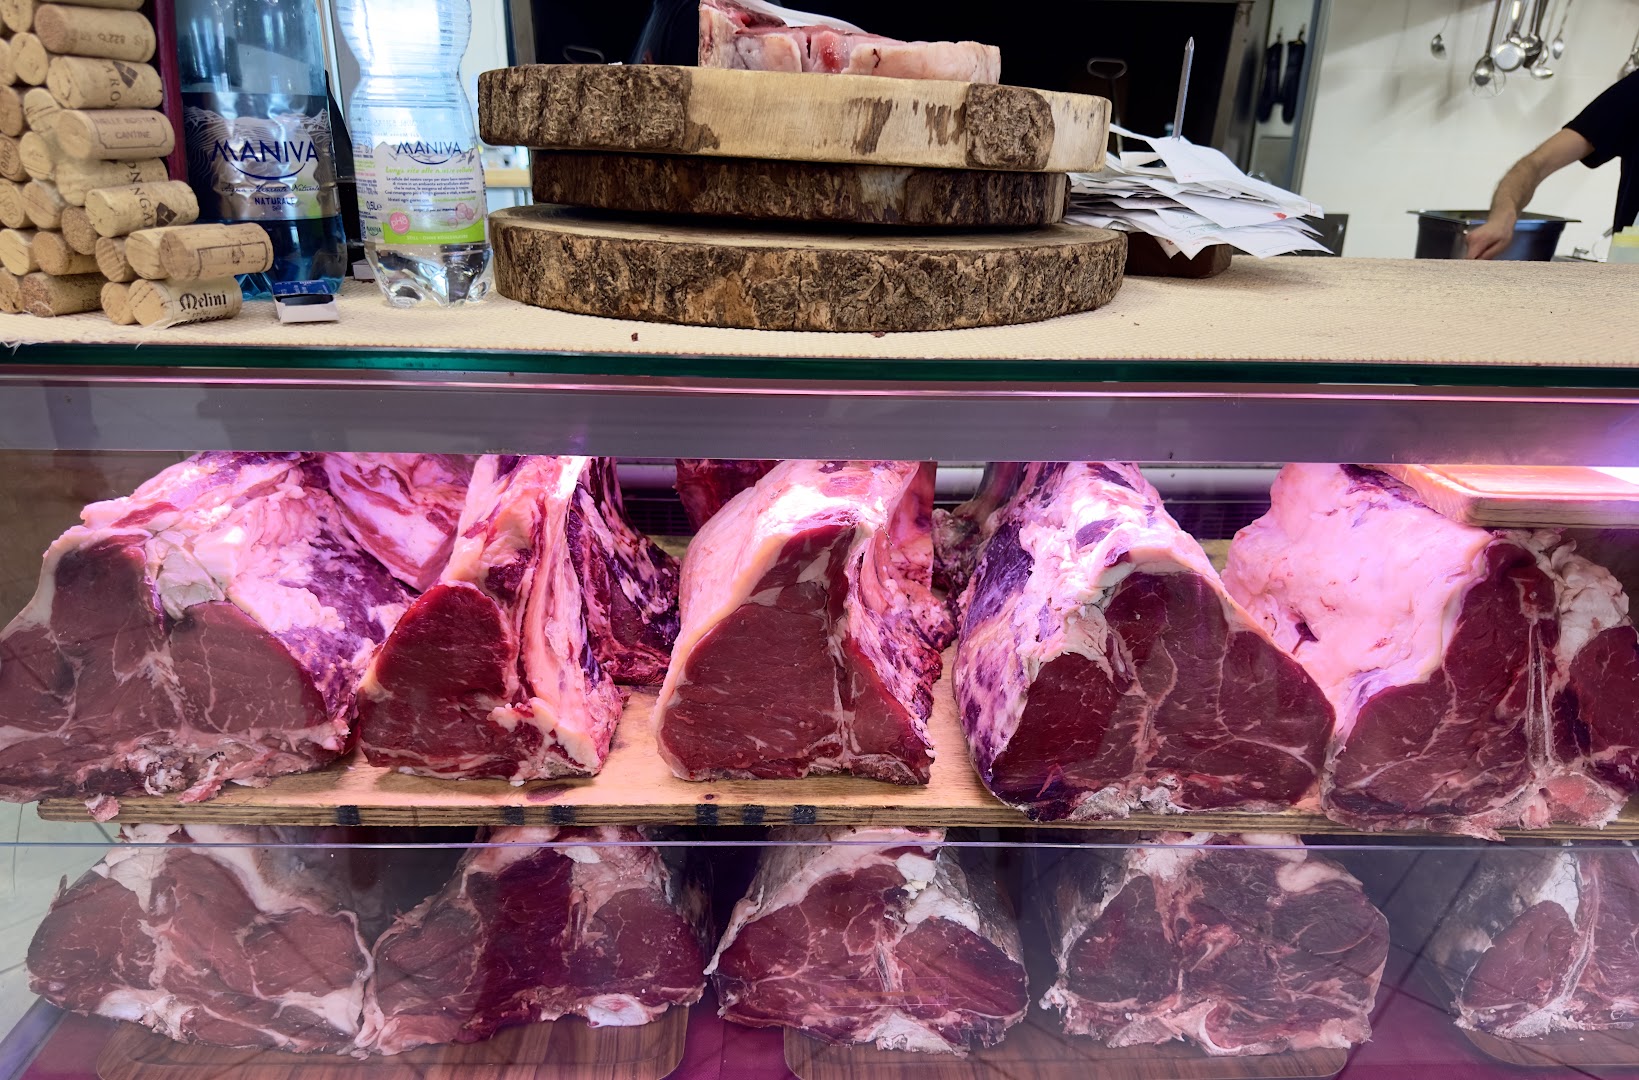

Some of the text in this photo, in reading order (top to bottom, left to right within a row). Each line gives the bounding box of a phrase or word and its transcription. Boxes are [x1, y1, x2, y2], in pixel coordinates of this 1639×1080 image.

[115, 130, 151, 139] CANTINE
[211, 139, 320, 163] MANIVA
[396, 140, 462, 154] MANIVA
[254, 197, 295, 205] NATURALE
[179, 291, 227, 312] Melini
